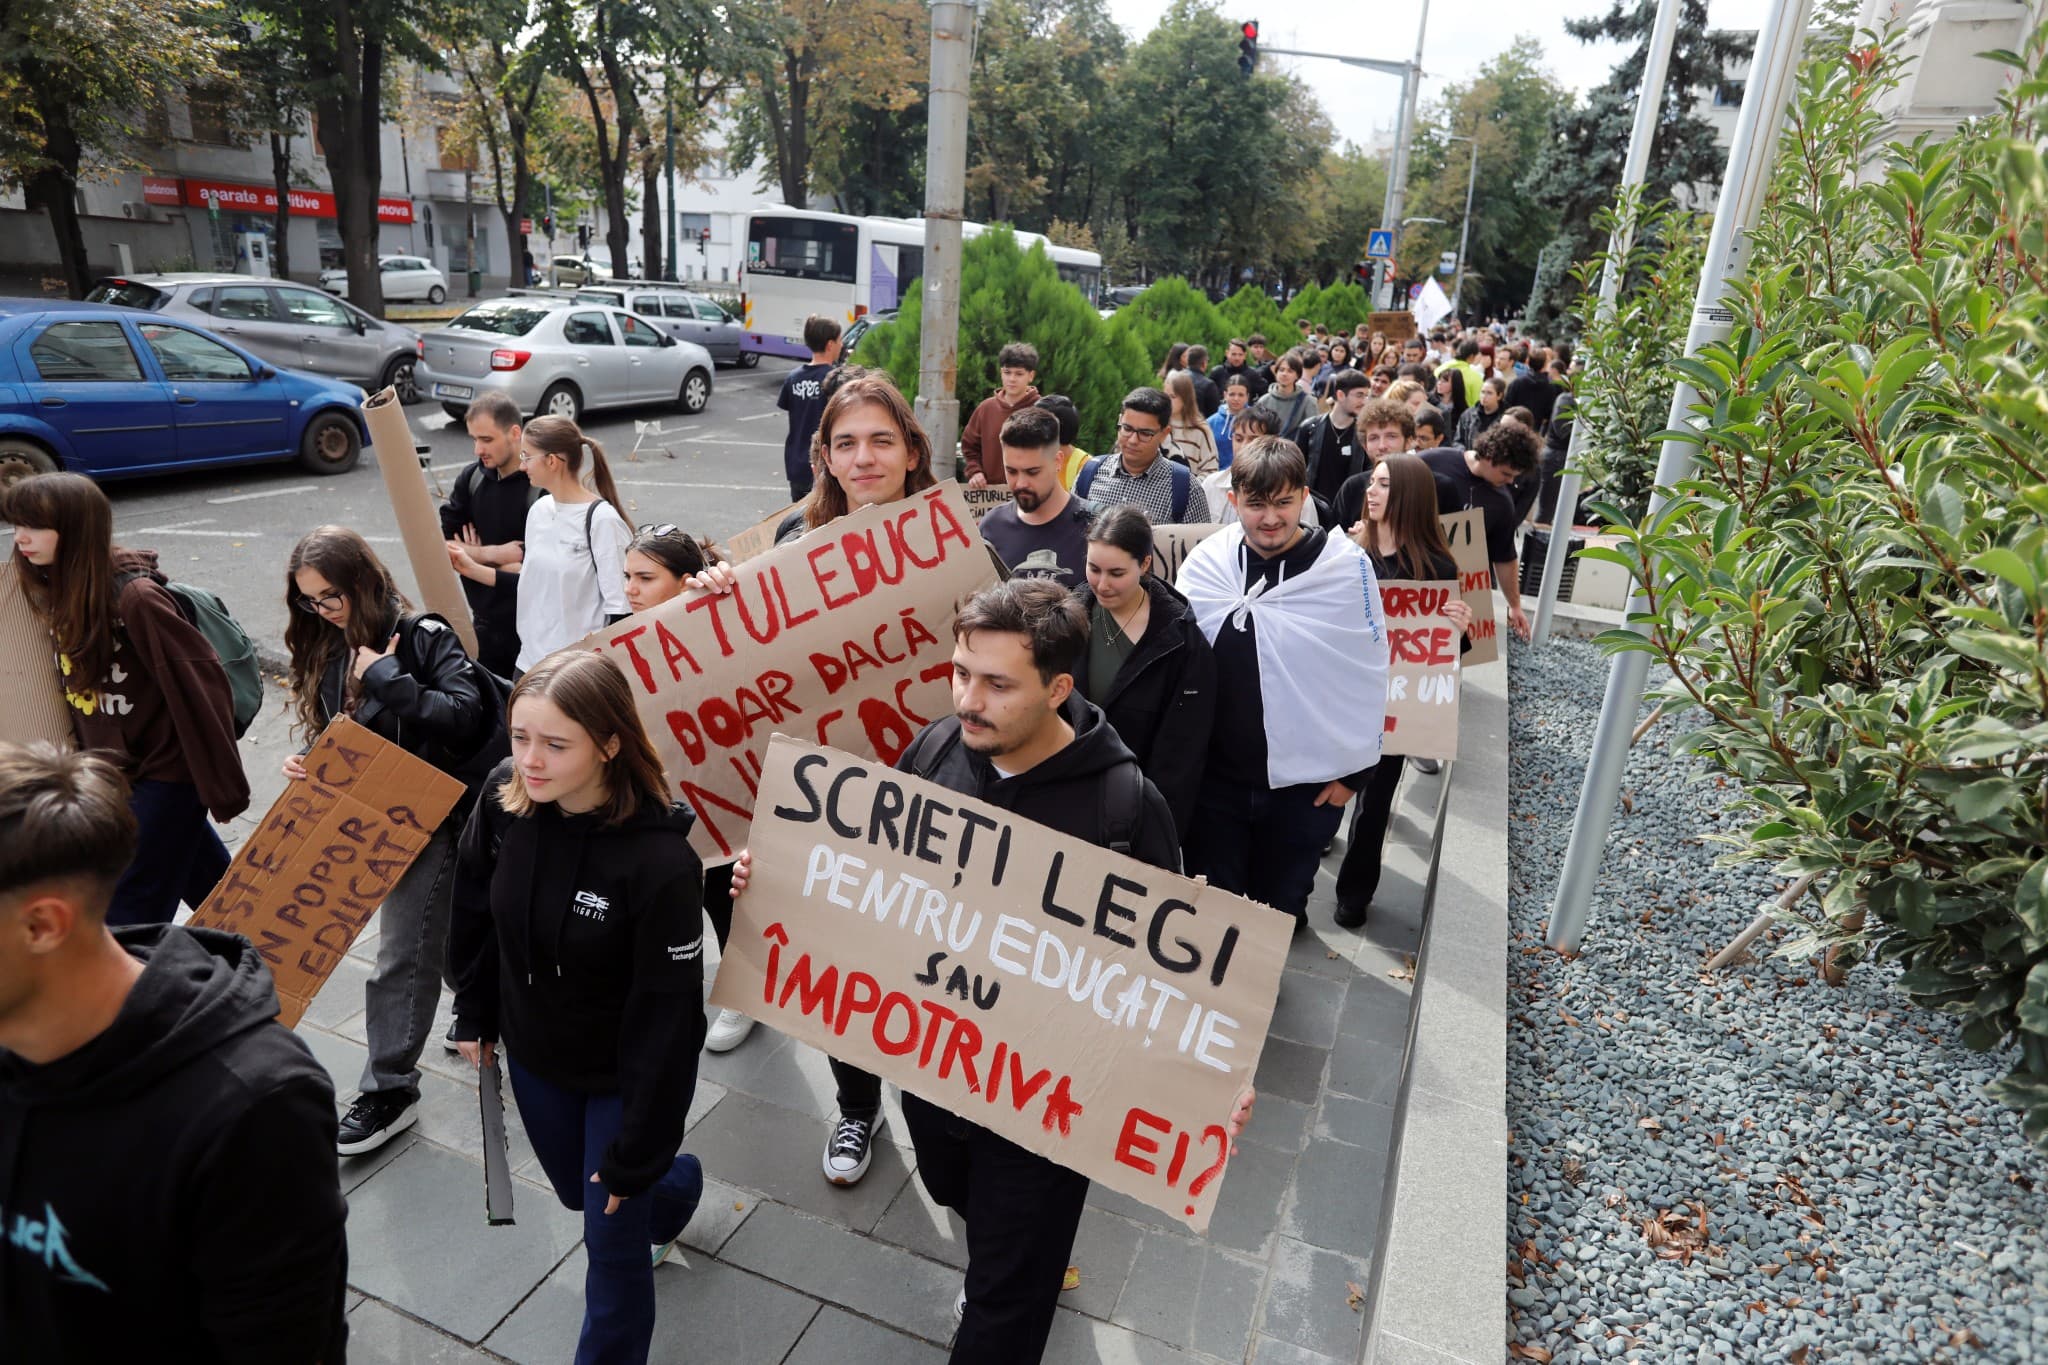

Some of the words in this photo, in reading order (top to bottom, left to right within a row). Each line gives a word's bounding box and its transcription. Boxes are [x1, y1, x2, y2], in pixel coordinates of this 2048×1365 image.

[265, 193, 320, 210] auitive
[594, 566, 818, 694] TATUL
[807, 489, 971, 610] EDUCĂ
[666, 670, 803, 766] DOAR
[809, 607, 939, 695] DACĂ
[1386, 674, 1409, 702] R
[1417, 672, 1455, 705] UN
[275, 815, 380, 929] POPOR
[801, 843, 985, 953] PENTRU
[1040, 851, 1241, 988] LEGI
[914, 950, 1001, 1011] SAU
[1114, 1106, 1229, 1217] EI?
